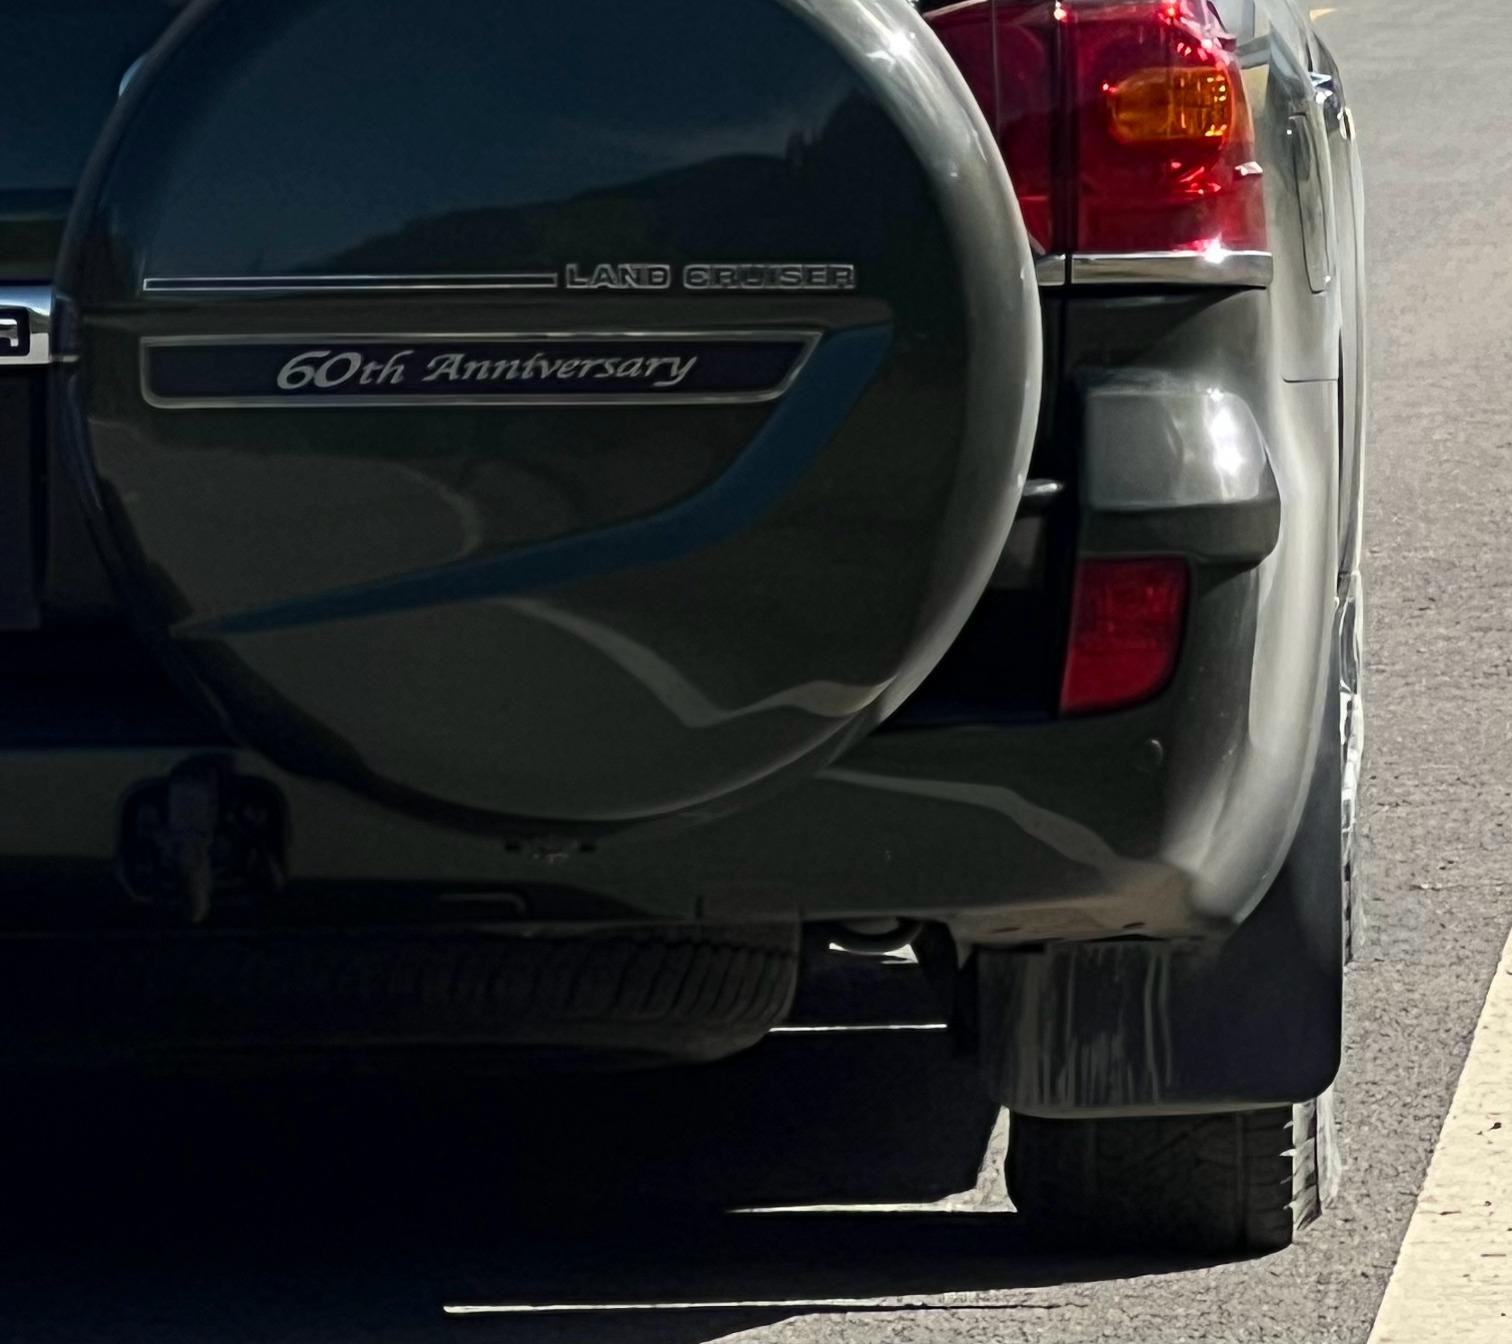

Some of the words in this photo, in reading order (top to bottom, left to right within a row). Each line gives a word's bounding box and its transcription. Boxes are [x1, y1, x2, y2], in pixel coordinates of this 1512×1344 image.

[565, 264, 671, 289] LAND
[683, 264, 856, 289] CRUISER
[276, 350, 415, 390] 60th
[421, 353, 698, 387] Anniversary
